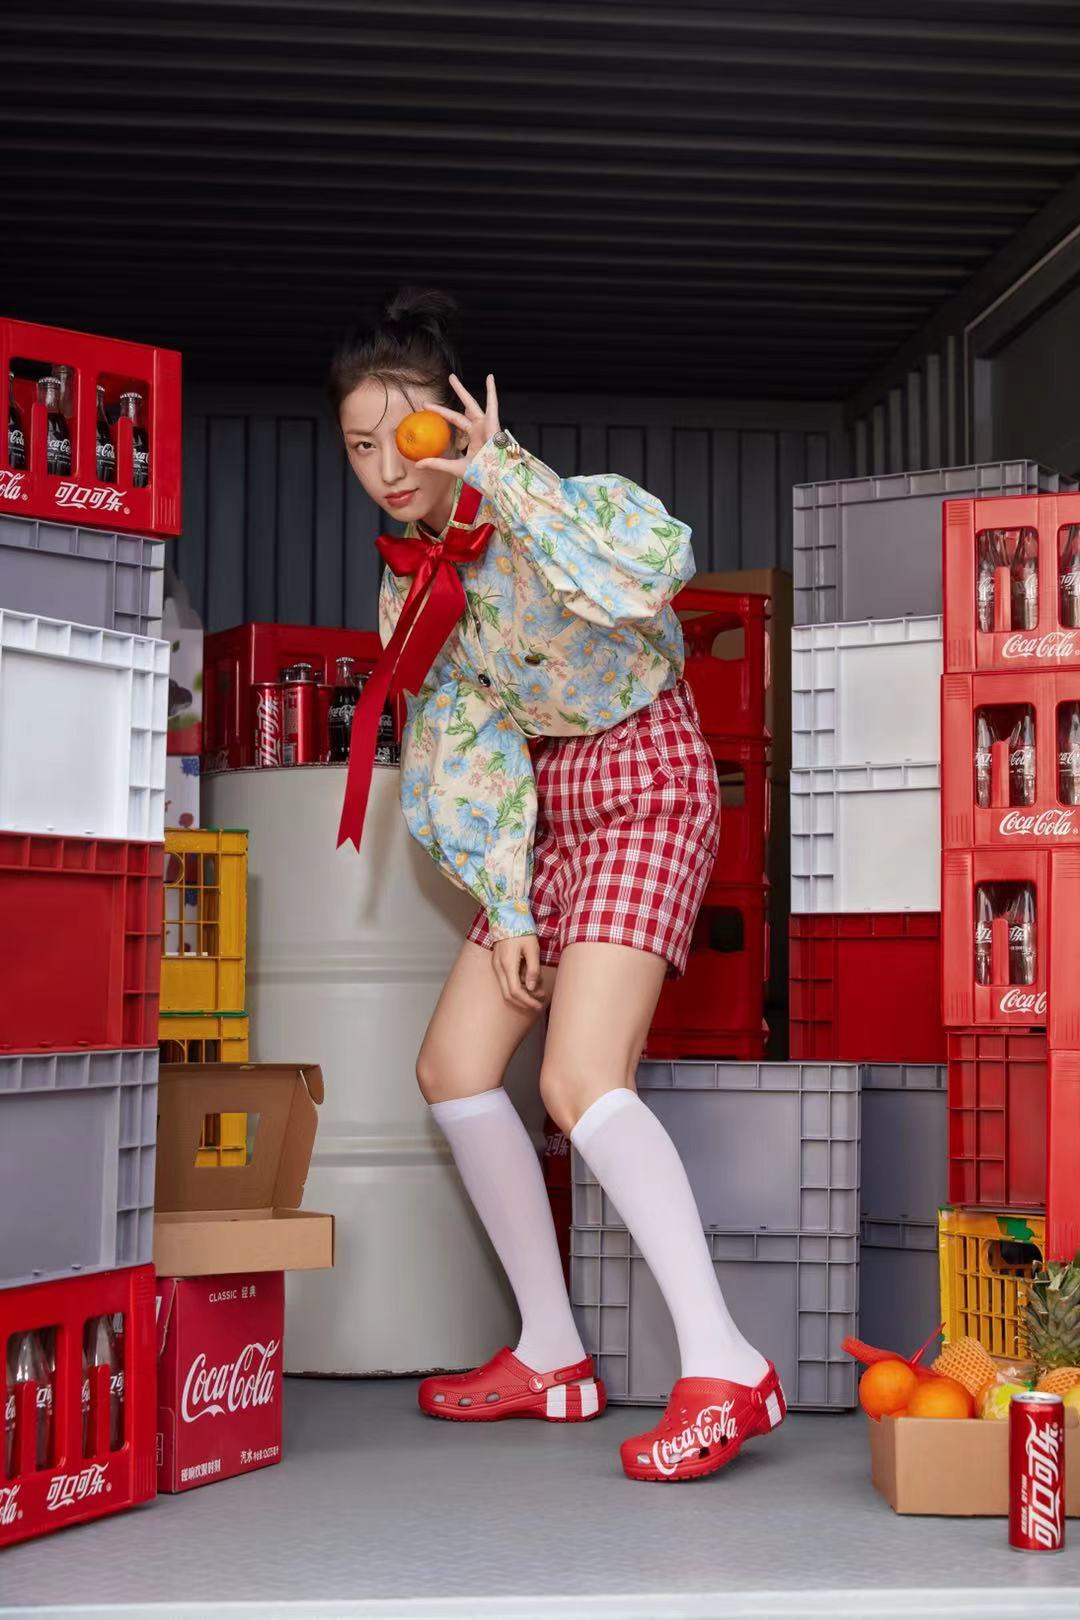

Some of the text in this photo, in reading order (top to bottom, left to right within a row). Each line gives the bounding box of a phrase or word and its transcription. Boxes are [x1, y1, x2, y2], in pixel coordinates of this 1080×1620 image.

[55, 481, 127, 512] 可口可乐
[209, 1284, 256, 1303] CLASSIC 经典
[47, 1461, 109, 1511] 可口可乐
[1025, 1413, 1061, 1549] 可口可乐
